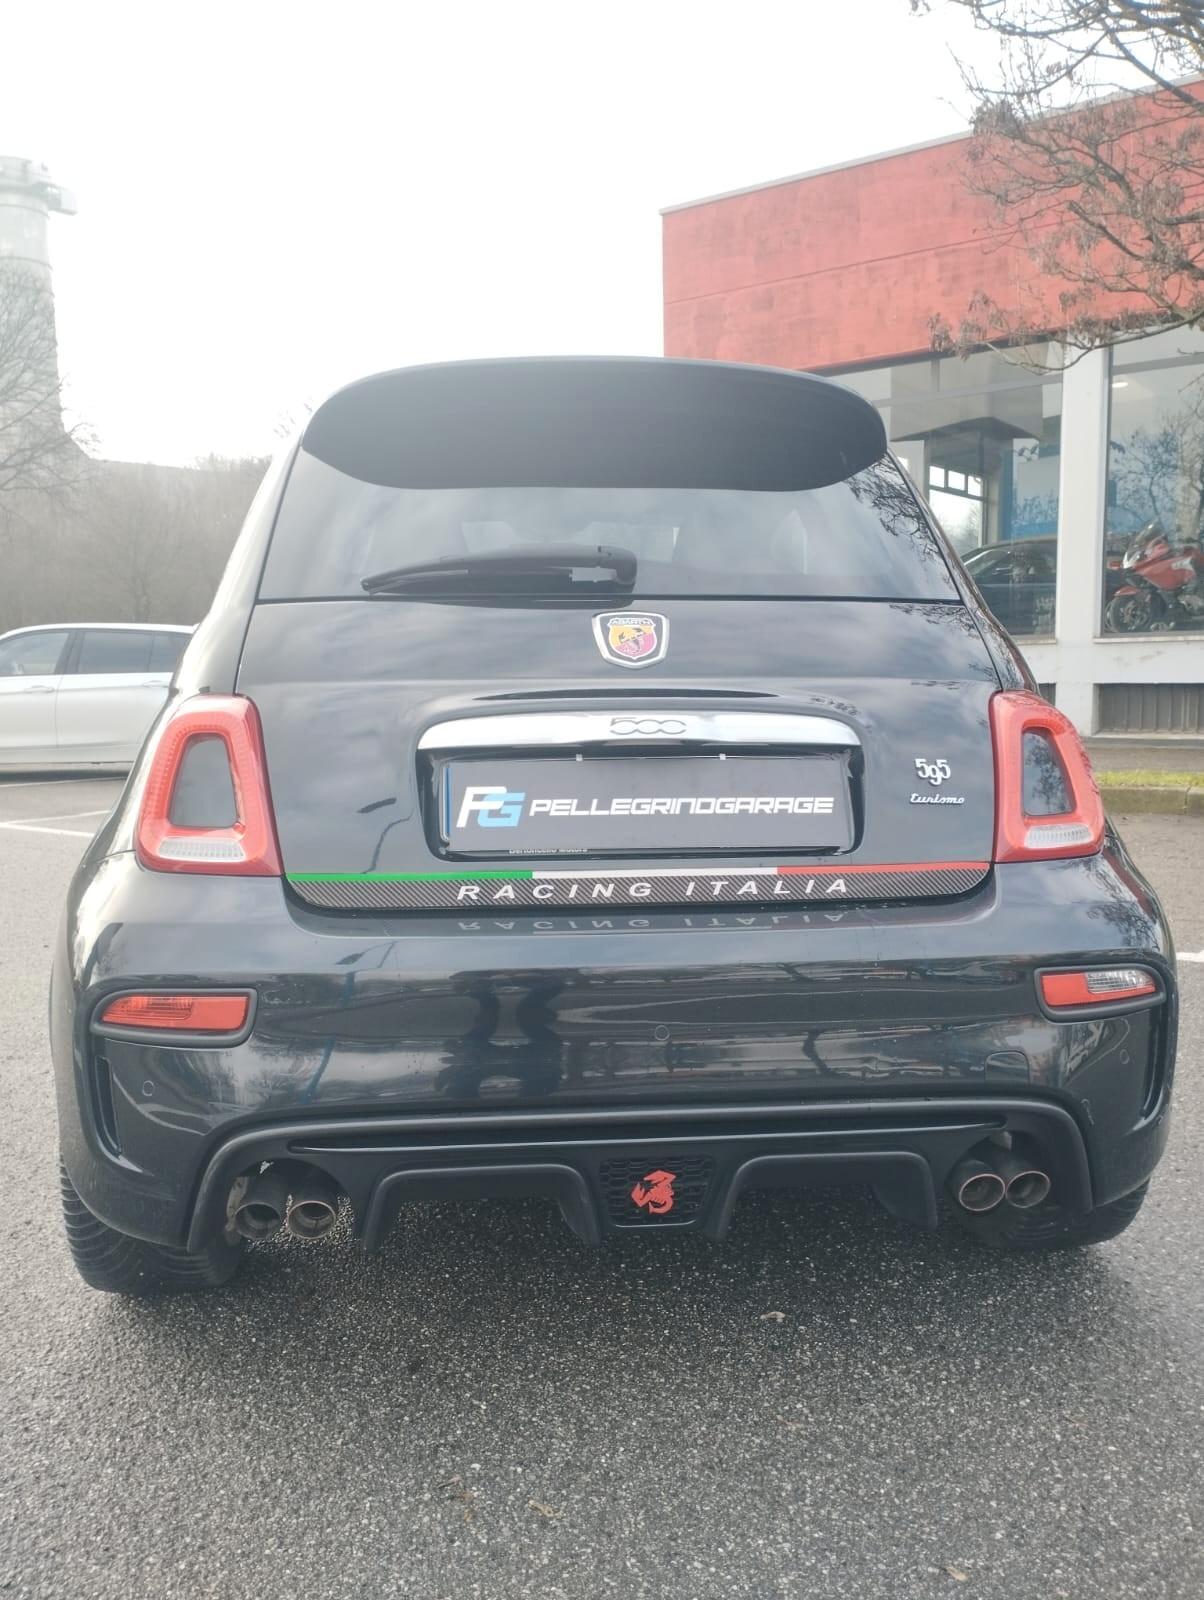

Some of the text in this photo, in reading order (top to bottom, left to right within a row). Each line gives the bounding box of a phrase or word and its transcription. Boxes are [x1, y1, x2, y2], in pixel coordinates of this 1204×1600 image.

[609, 717, 687, 735] 500
[914, 758, 951, 786] 595
[529, 797, 834, 817] PELLEGRINOGARAGE
[457, 878, 848, 900] RACING ITALIA
